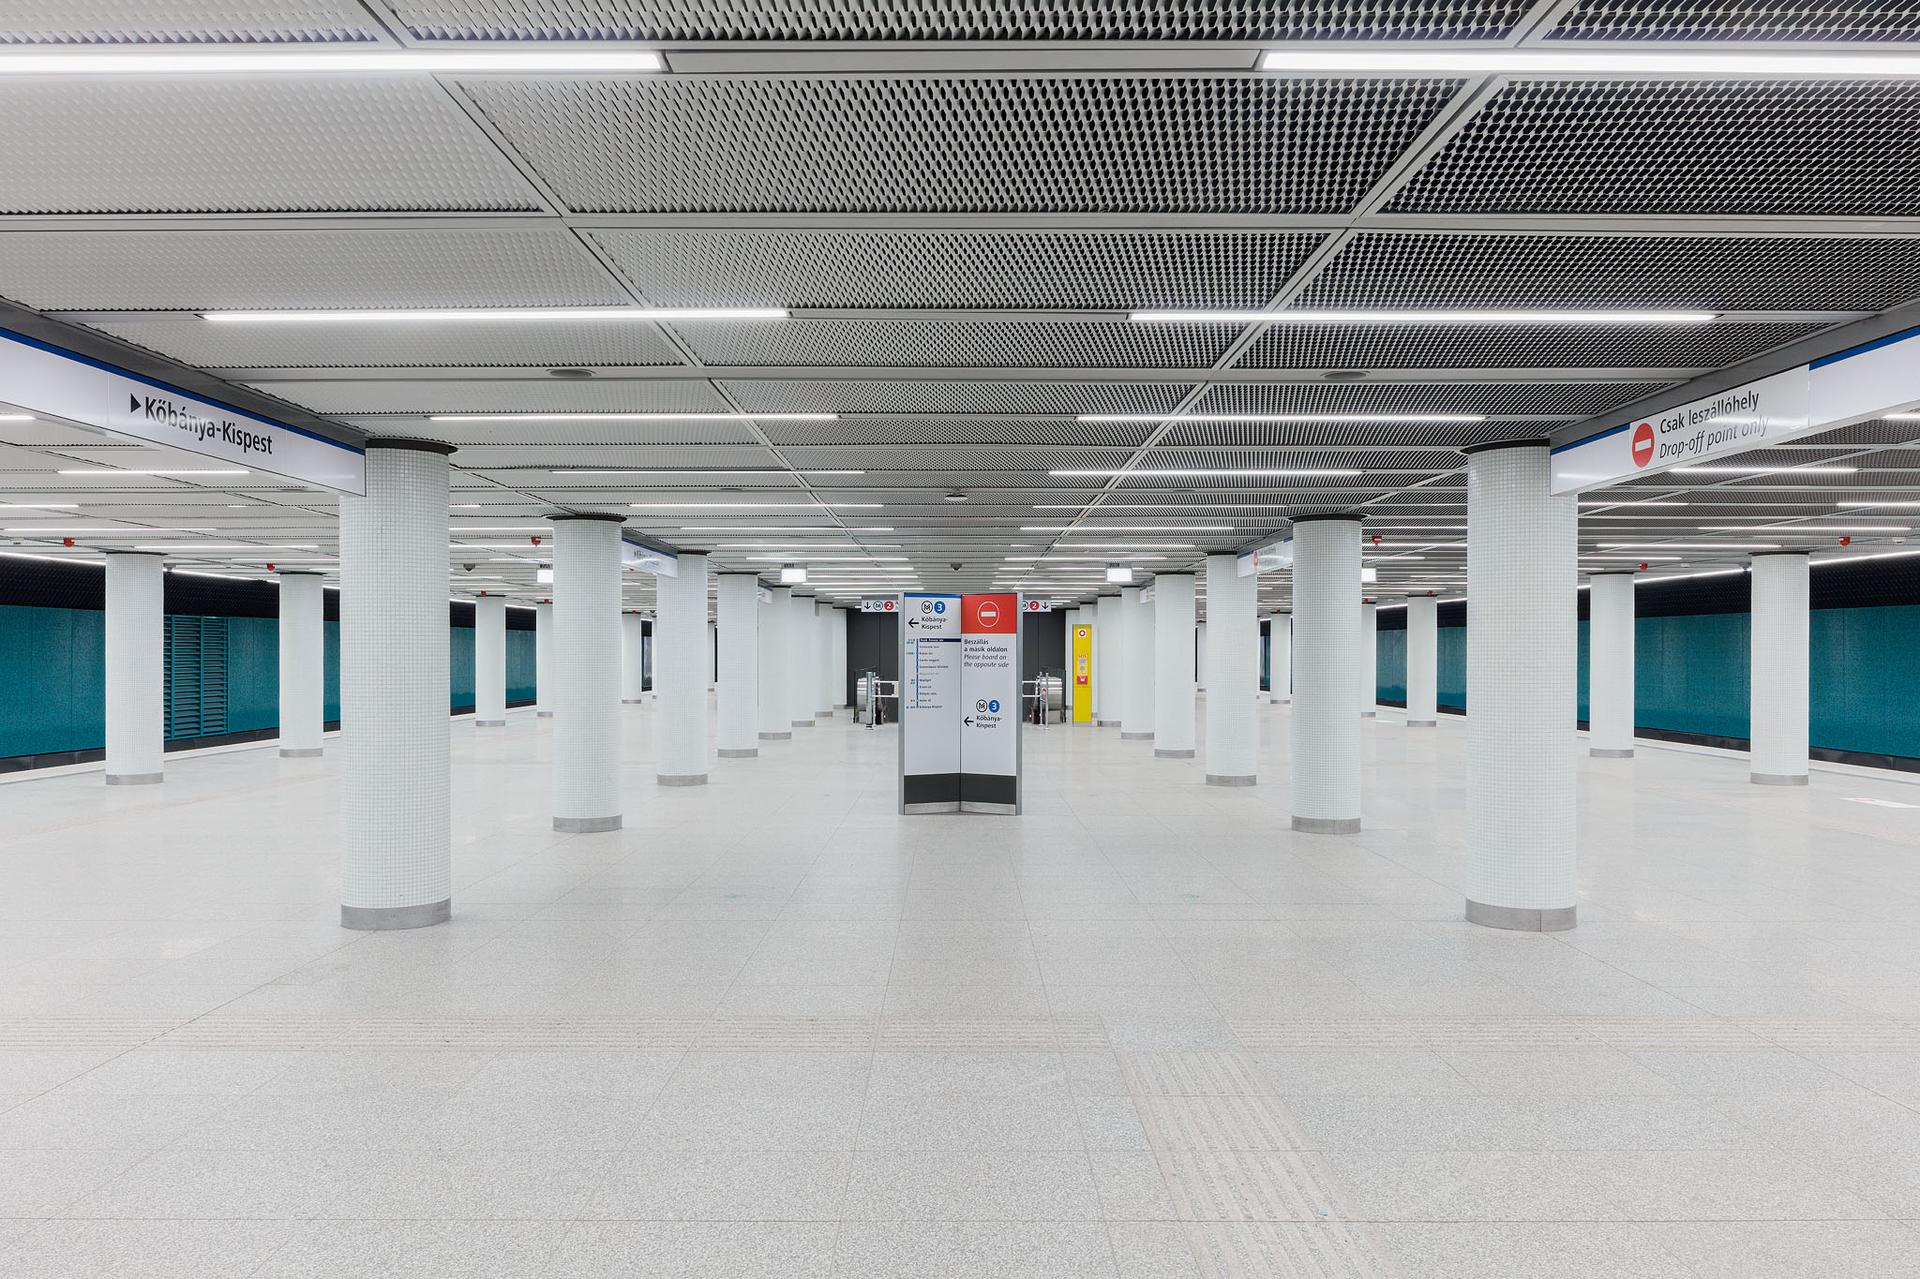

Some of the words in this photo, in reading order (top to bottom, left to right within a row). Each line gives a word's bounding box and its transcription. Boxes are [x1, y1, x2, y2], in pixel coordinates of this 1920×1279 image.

[145, 396, 273, 455] Kőbánya-Kispest
[1660, 412, 1685, 434] Csak
[1688, 390, 1760, 426] leszállóhely
[1659, 430, 1705, 459] Drop-off
[1706, 424, 1738, 451] point
[1741, 413, 1769, 438] only
